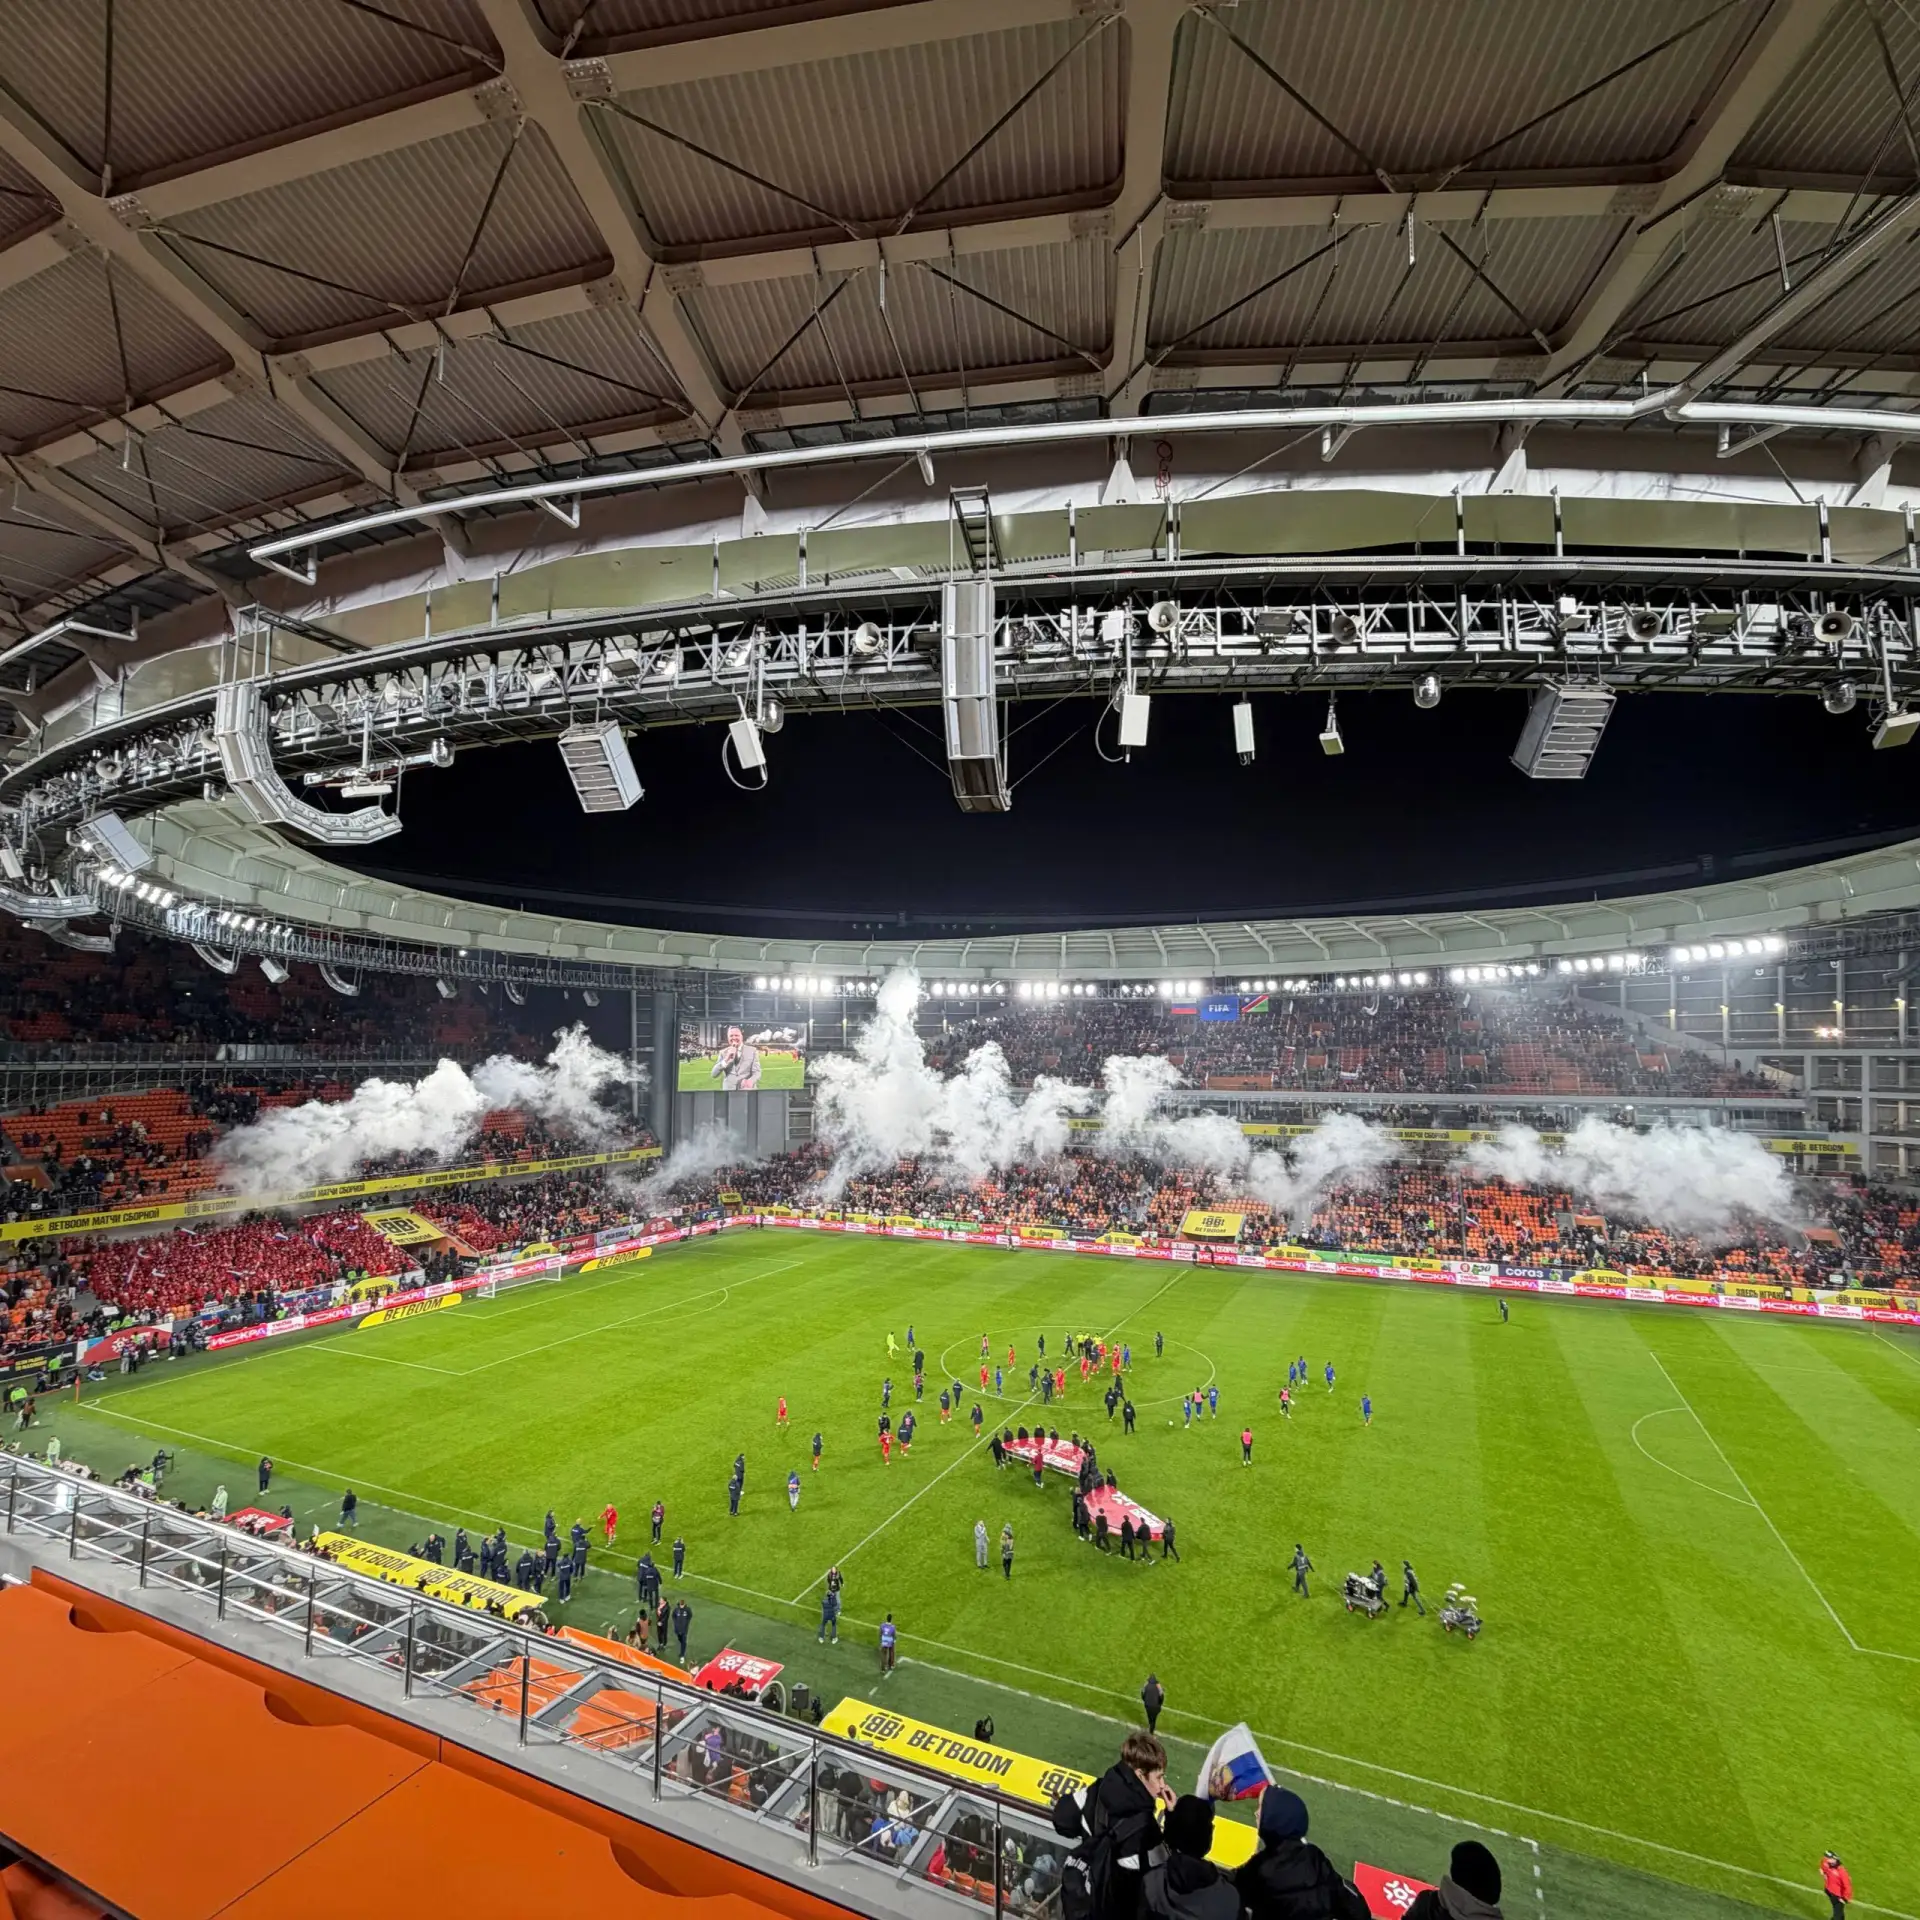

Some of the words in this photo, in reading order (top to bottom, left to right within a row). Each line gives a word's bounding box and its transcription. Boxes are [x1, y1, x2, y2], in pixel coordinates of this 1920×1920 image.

[1208, 1004, 1230, 1013] FIFA
[1809, 1143, 1845, 1153] BETBOOM
[48, 1217, 90, 1232] BETBOOM
[92, 1214, 121, 1226] МАТЧИ
[123, 1207, 160, 1222] СБОРНОЙ
[597, 1250, 639, 1269] BETBOOM
[1337, 1265, 1378, 1276] ИСКРА
[1411, 1272, 1456, 1283] ИСКРА
[1597, 1275, 1628, 1285] BETBOOM
[1491, 1278, 1539, 1290] ИСКРА
[1574, 1285, 1626, 1298] ИСКРА
[1735, 1287, 1758, 1298] ЗДЕСЬ
[1665, 1293, 1720, 1304] ИСКРА
[1854, 1297, 1890, 1306] BETBOOM
[383, 1297, 443, 1322] BETBOOM
[1760, 1302, 1819, 1314] ИСКРА
[212, 1327, 268, 1346] ИСКРА
[349, 1544, 416, 1573] BETBOOM
[445, 1577, 520, 1605] BETBOOM
[906, 1728, 1014, 1777] BETBOOM
